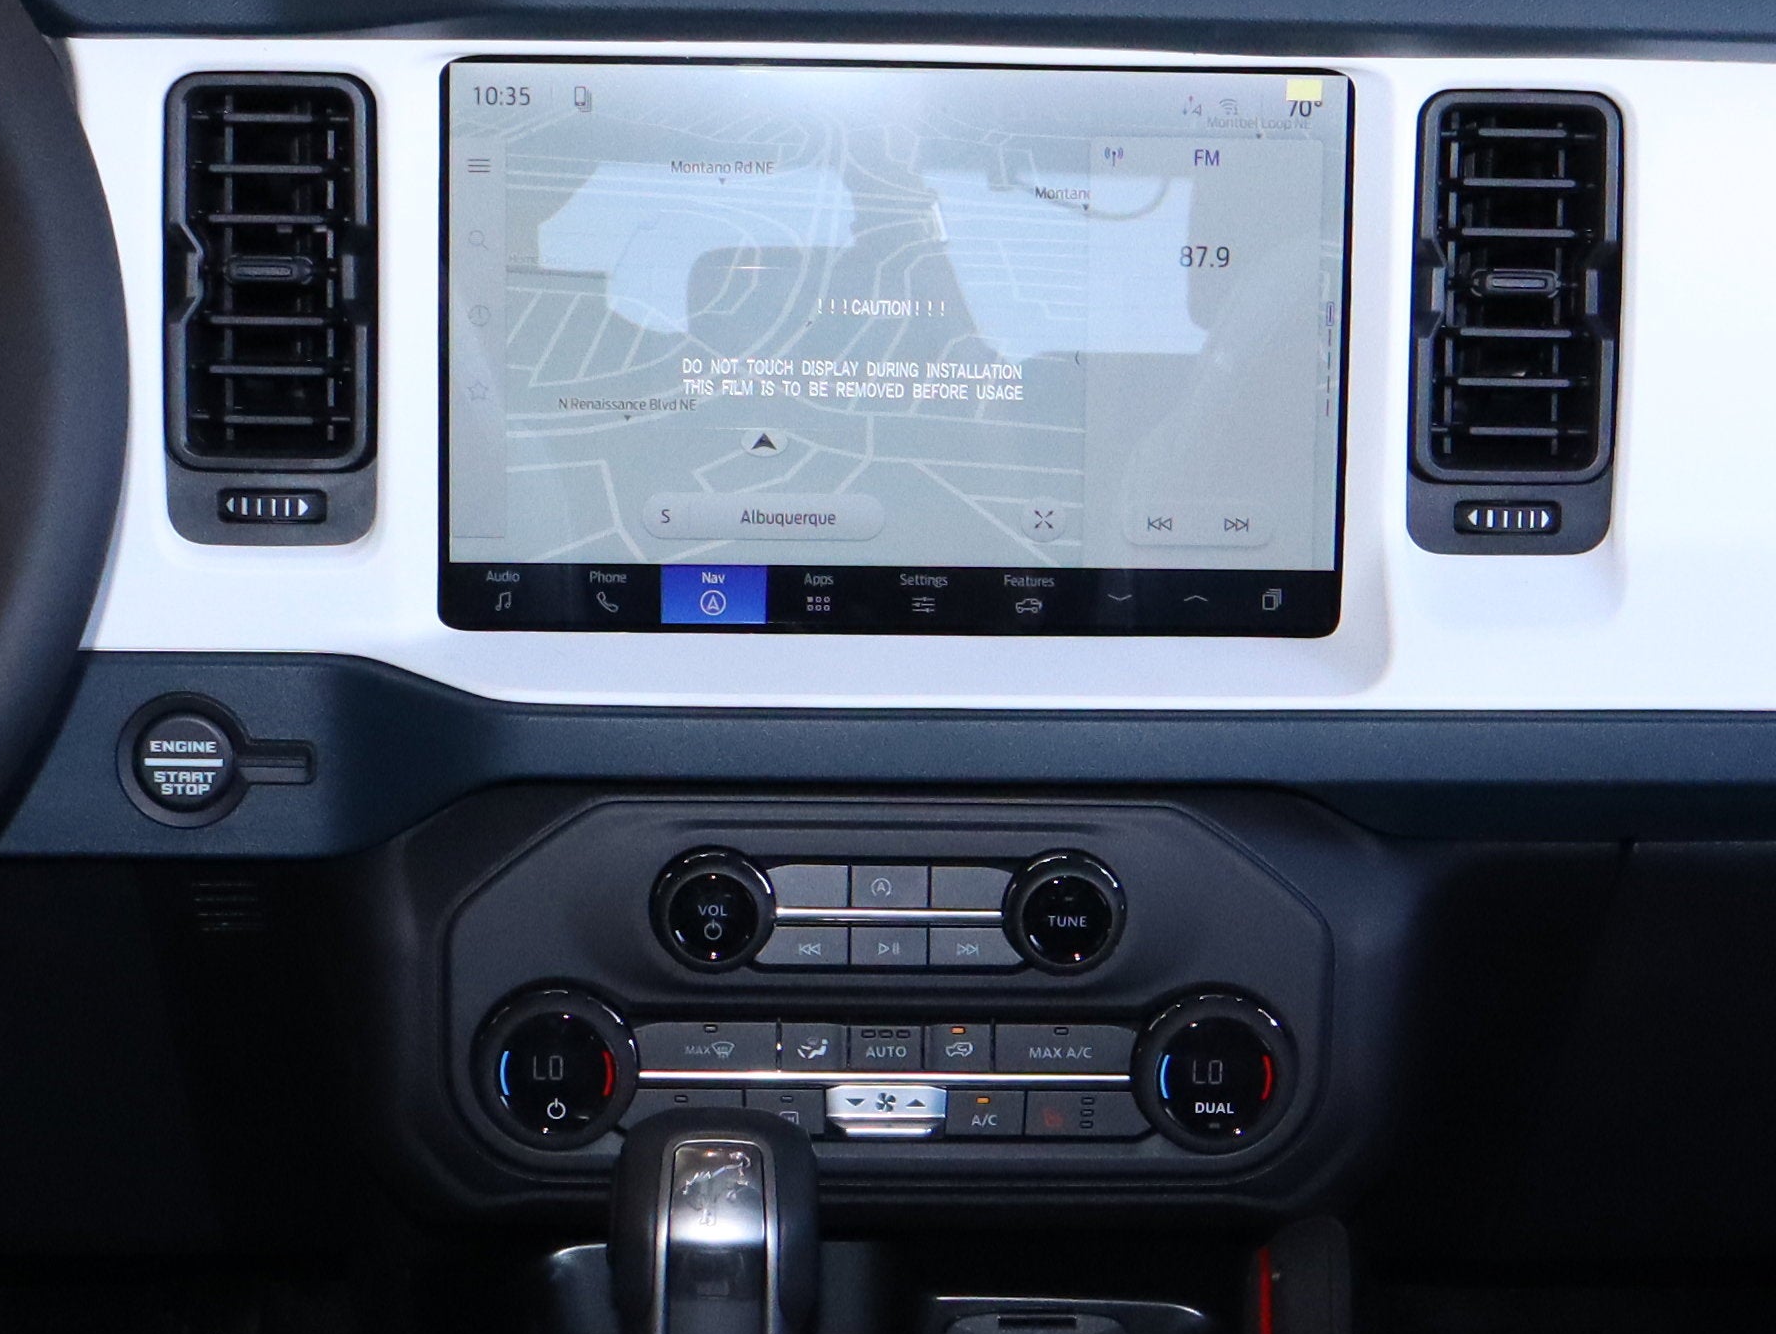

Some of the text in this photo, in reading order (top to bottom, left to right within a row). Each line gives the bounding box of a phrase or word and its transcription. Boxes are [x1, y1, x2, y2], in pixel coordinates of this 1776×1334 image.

[473, 85, 532, 107] 10:35
[1193, 149, 1221, 167] FM
[670, 160, 775, 175] Montano Rd NE
[1179, 245, 1231, 268] 87.9
[682, 358, 1023, 380] DO NOT TOUCH DISPLAY DURING INSTALLATION
[683, 379, 1025, 401] THIS FILM IS TO BE REMOVED BEFORE USAGE
[558, 397, 697, 411] N Renaissance Blvd NE
[660, 509, 671, 525] S
[740, 509, 837, 527] Albuquerque
[485, 569, 521, 584] Audio
[588, 569, 628, 585] Phone
[700, 571, 726, 585] Nav
[803, 572, 835, 588] Apps
[898, 572, 949, 589] Settings
[1003, 573, 1055, 588] Features
[149, 740, 217, 753] ENGINE
[153, 771, 217, 783] START
[161, 783, 211, 796] STOP
[697, 904, 729, 918] VOL
[1047, 914, 1088, 928] TUNE
[684, 1043, 711, 1056] MAX
[865, 1045, 907, 1059] AUTO
[1028, 1045, 1094, 1060] MAX A/C
[531, 1055, 564, 1082] LO
[1191, 1059, 1224, 1086] LO
[1194, 1101, 1235, 1115] DUAL
[970, 1113, 998, 1127] A/C
